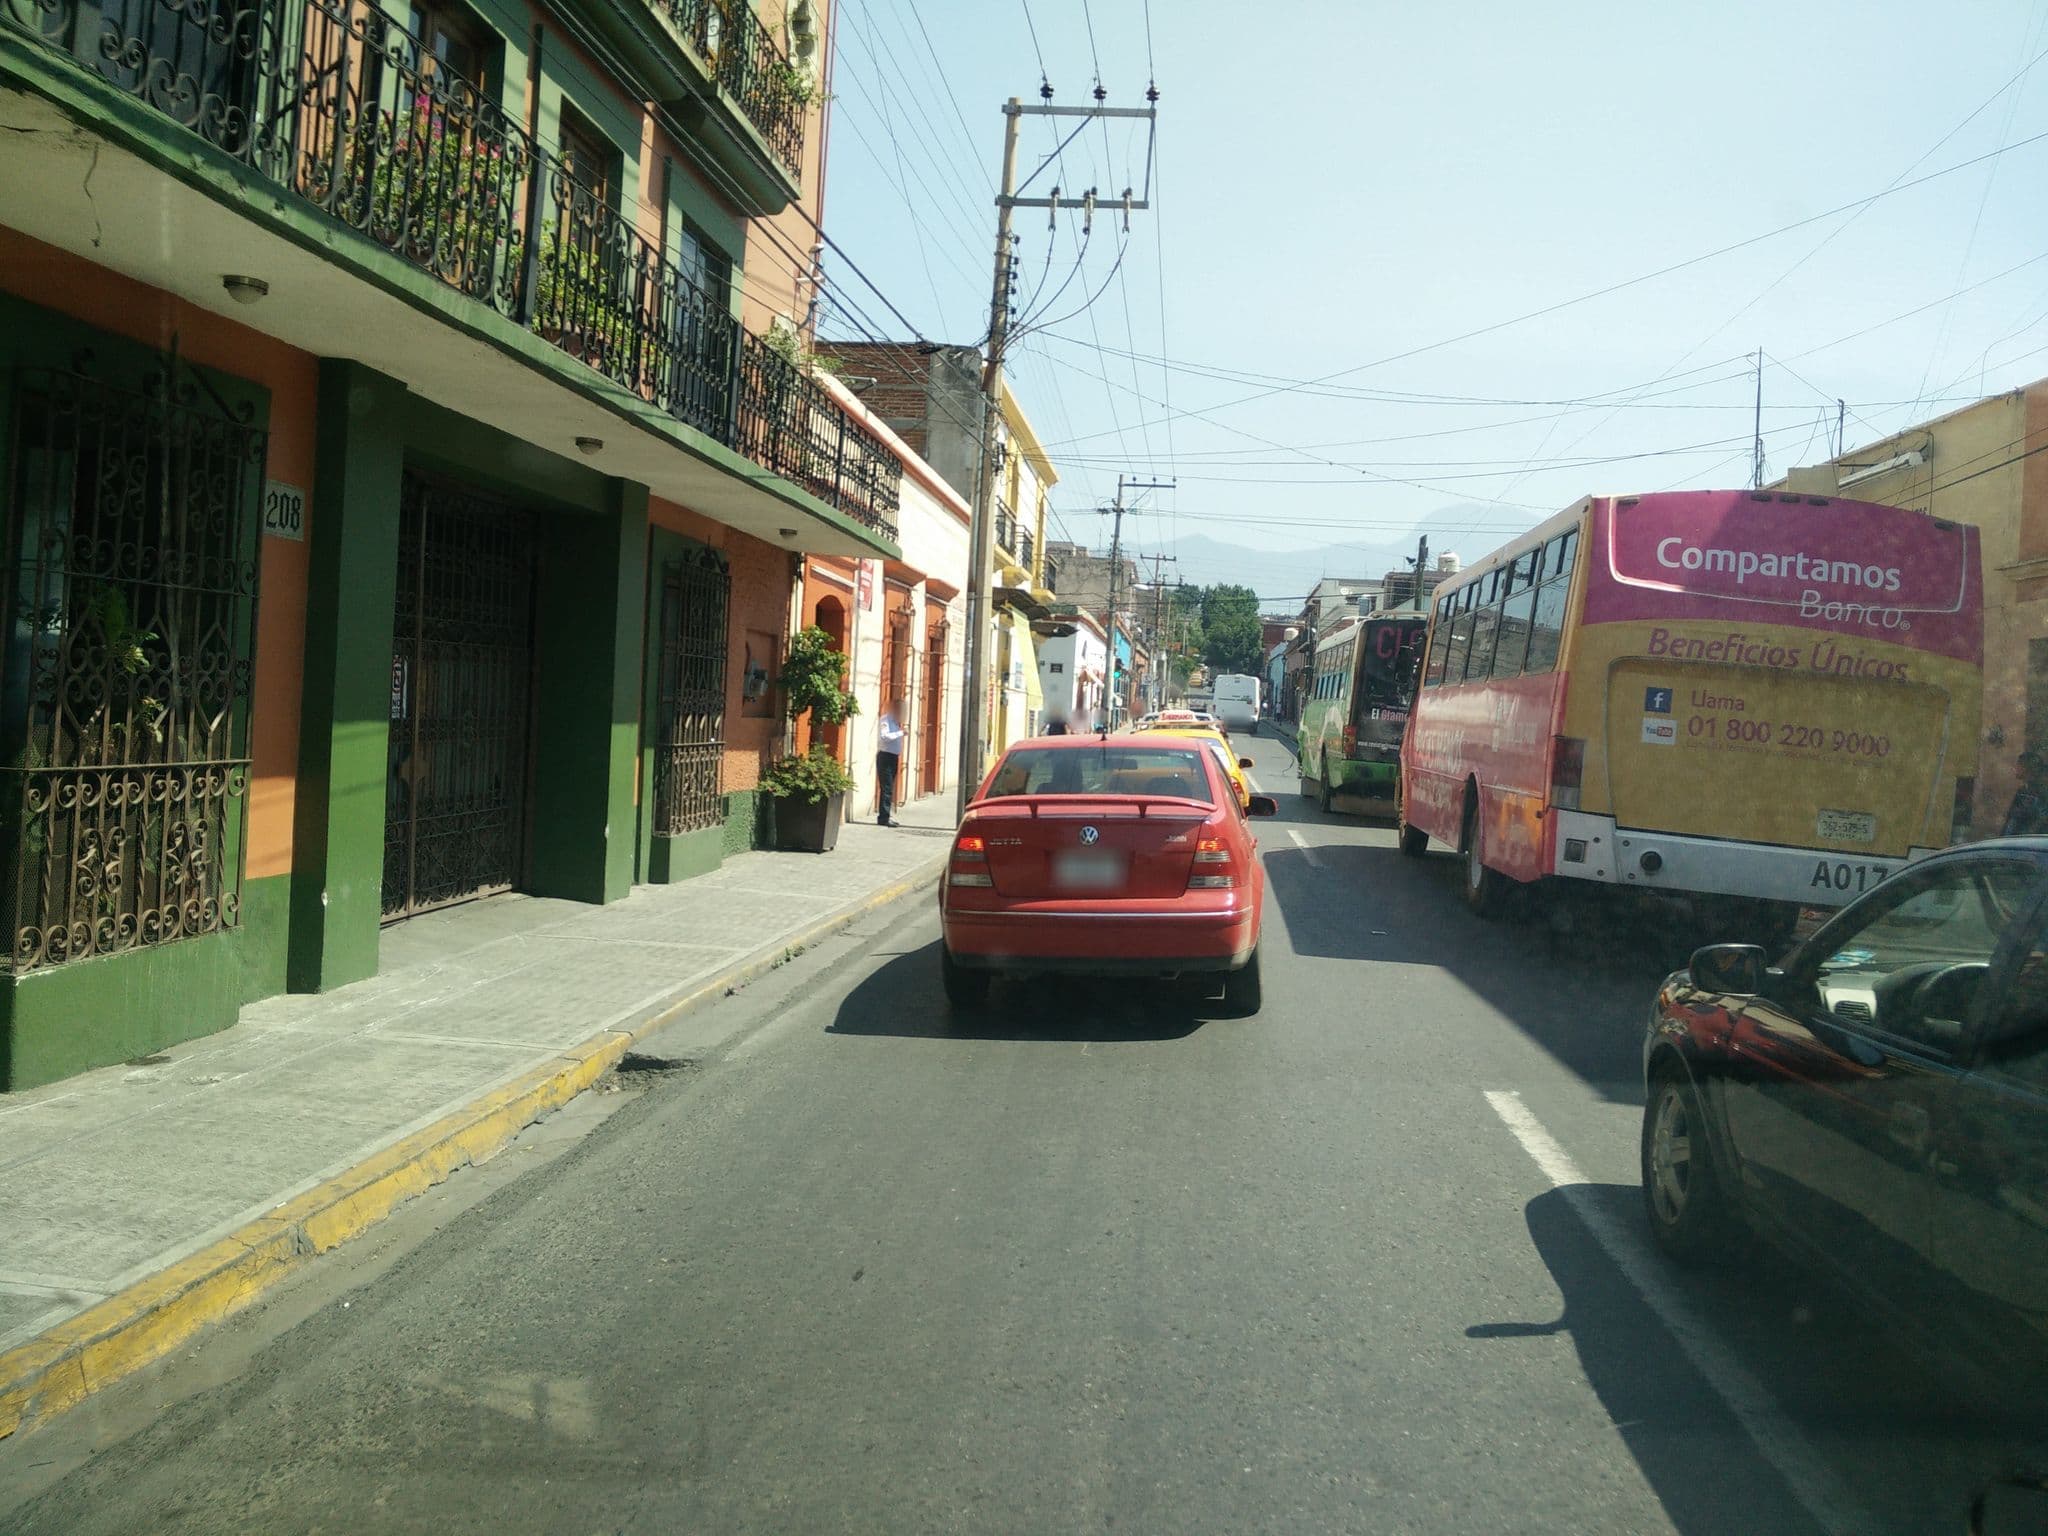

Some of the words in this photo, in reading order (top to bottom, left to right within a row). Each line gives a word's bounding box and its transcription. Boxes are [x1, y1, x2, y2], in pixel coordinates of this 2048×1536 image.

[266, 490, 300, 532] 208
[1657, 537, 1901, 592] Compartamos
[1649, 627, 1799, 669] Beneficios
[1809, 638, 1908, 681] Únicos
[1371, 708, 1380, 720] El
[1691, 689, 1745, 711] Llama
[1688, 715, 1717, 738] 01
[1726, 718, 1772, 744] 800
[1778, 724, 1824, 749] 220
[1832, 729, 1891, 757] 9000
